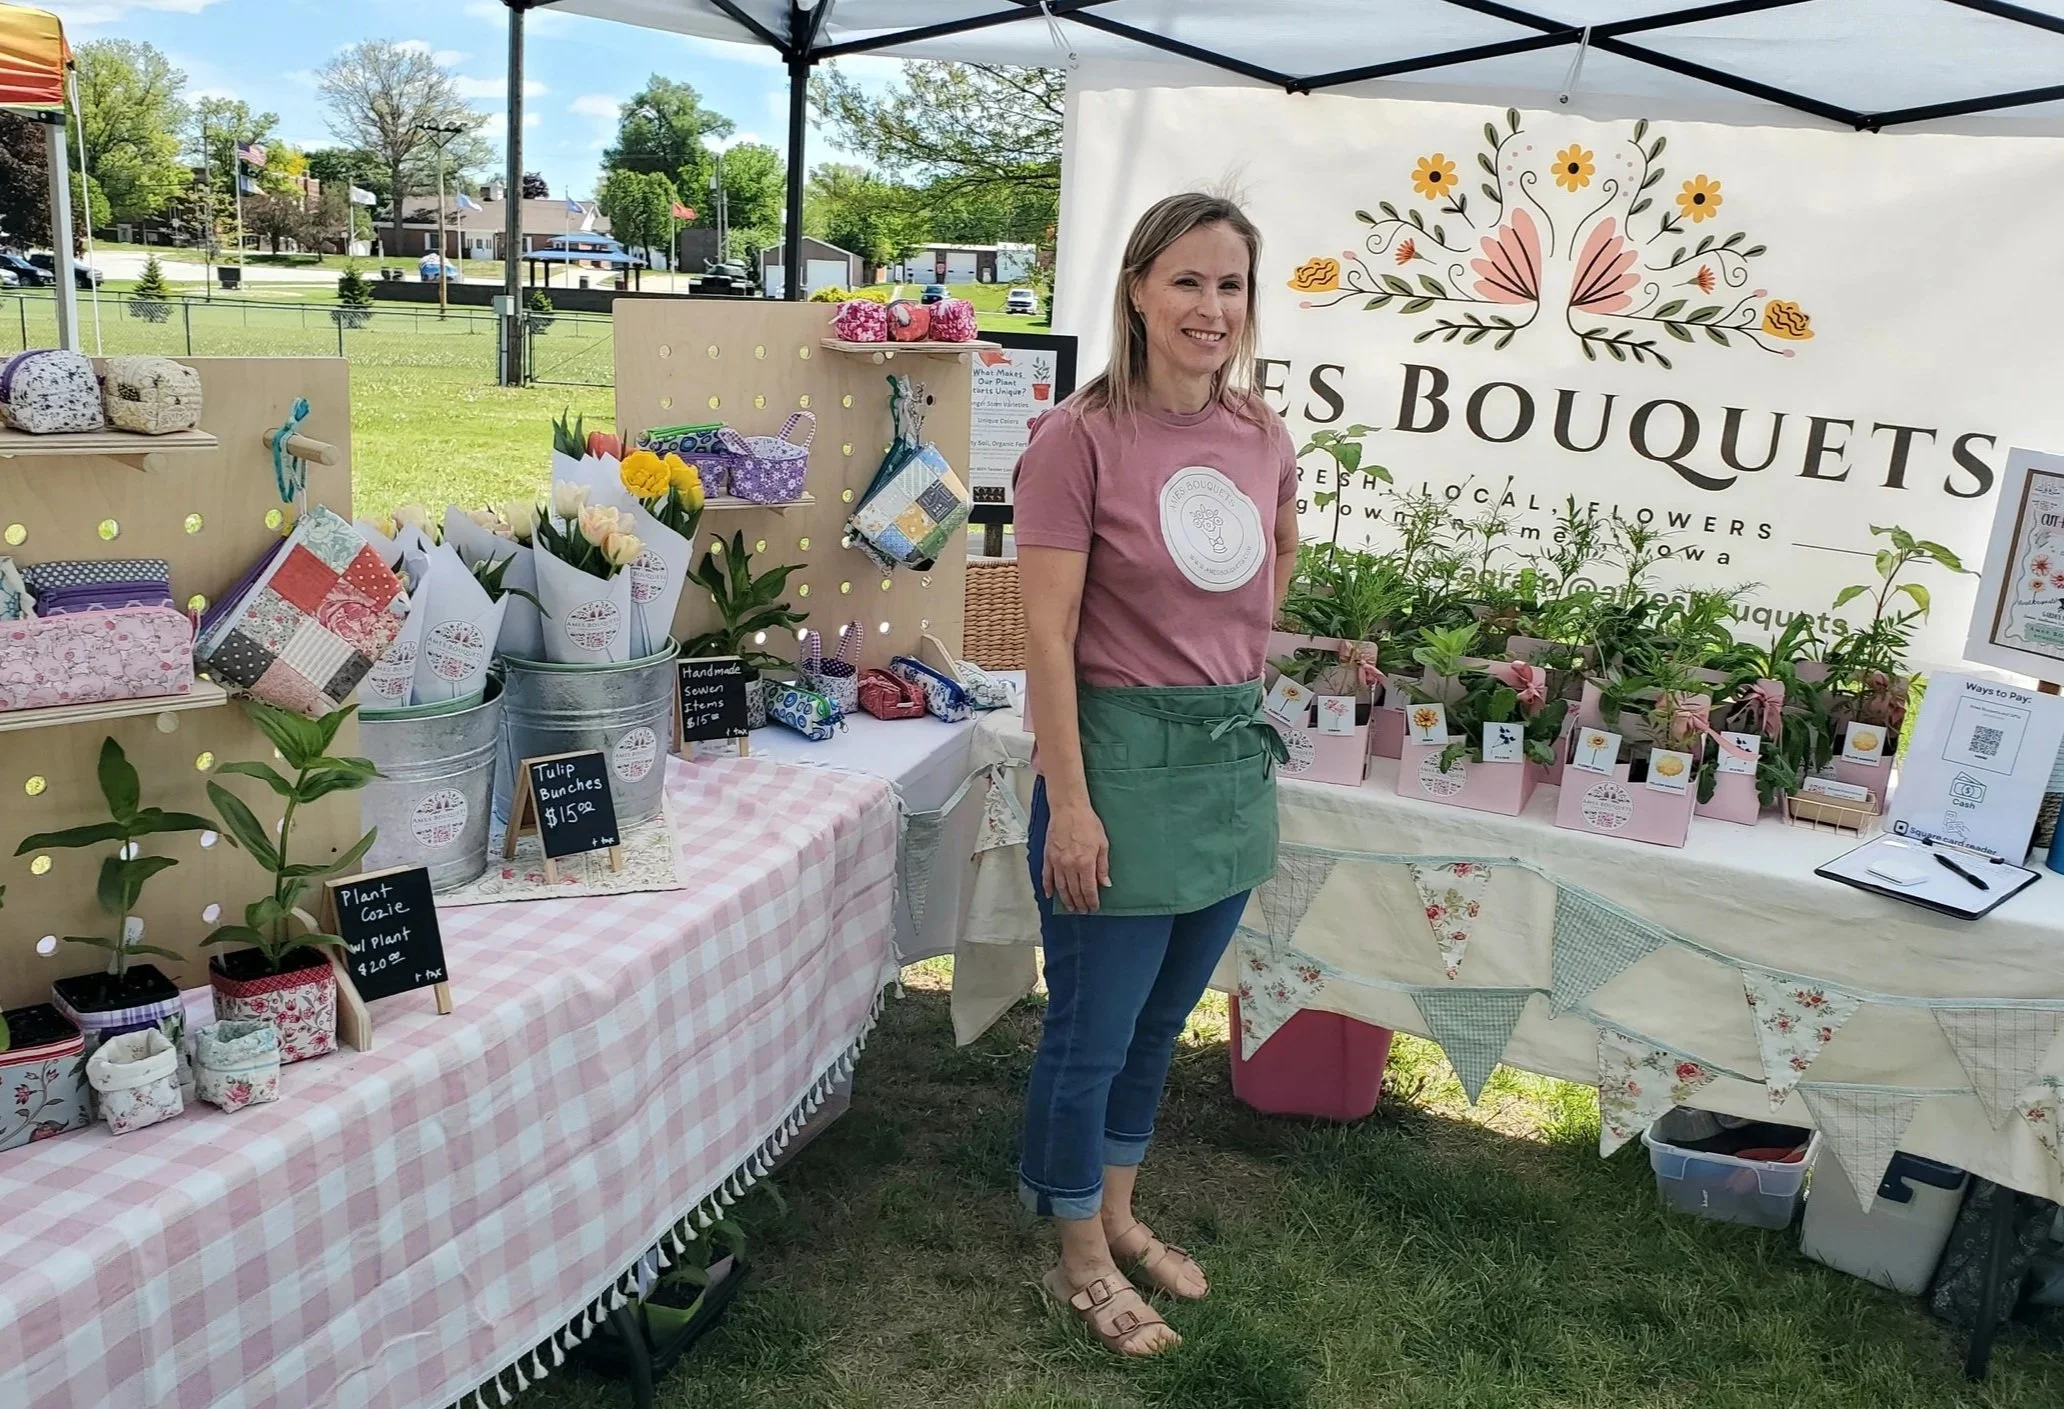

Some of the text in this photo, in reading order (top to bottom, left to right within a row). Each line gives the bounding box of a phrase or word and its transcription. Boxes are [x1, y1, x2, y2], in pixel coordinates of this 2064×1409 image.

[973, 369, 1024, 379] What Makes
[996, 378, 1017, 386] Plant
[972, 387, 1027, 397] tarts Unique?
[1391, 362, 1997, 499] BOUQUETS
[1588, 501, 1773, 540] FLOWERS
[1657, 543, 1731, 565] owa
[682, 662, 743, 679] Handmade
[1965, 681, 2033, 704] Ways to Pay:
[684, 699, 725, 713] Items
[733, 727, 748, 736] tax
[533, 762, 576, 782] Tulip
[539, 778, 603, 801] Bunches
[1952, 798, 1976, 811] Cash
[601, 836, 615, 845] tax
[1909, 826, 1998, 856] Square card reader
[341, 883, 393, 907] Plant
[361, 901, 411, 922] Cozie
[371, 926, 412, 950] Plant
[425, 967, 443, 980] tax
